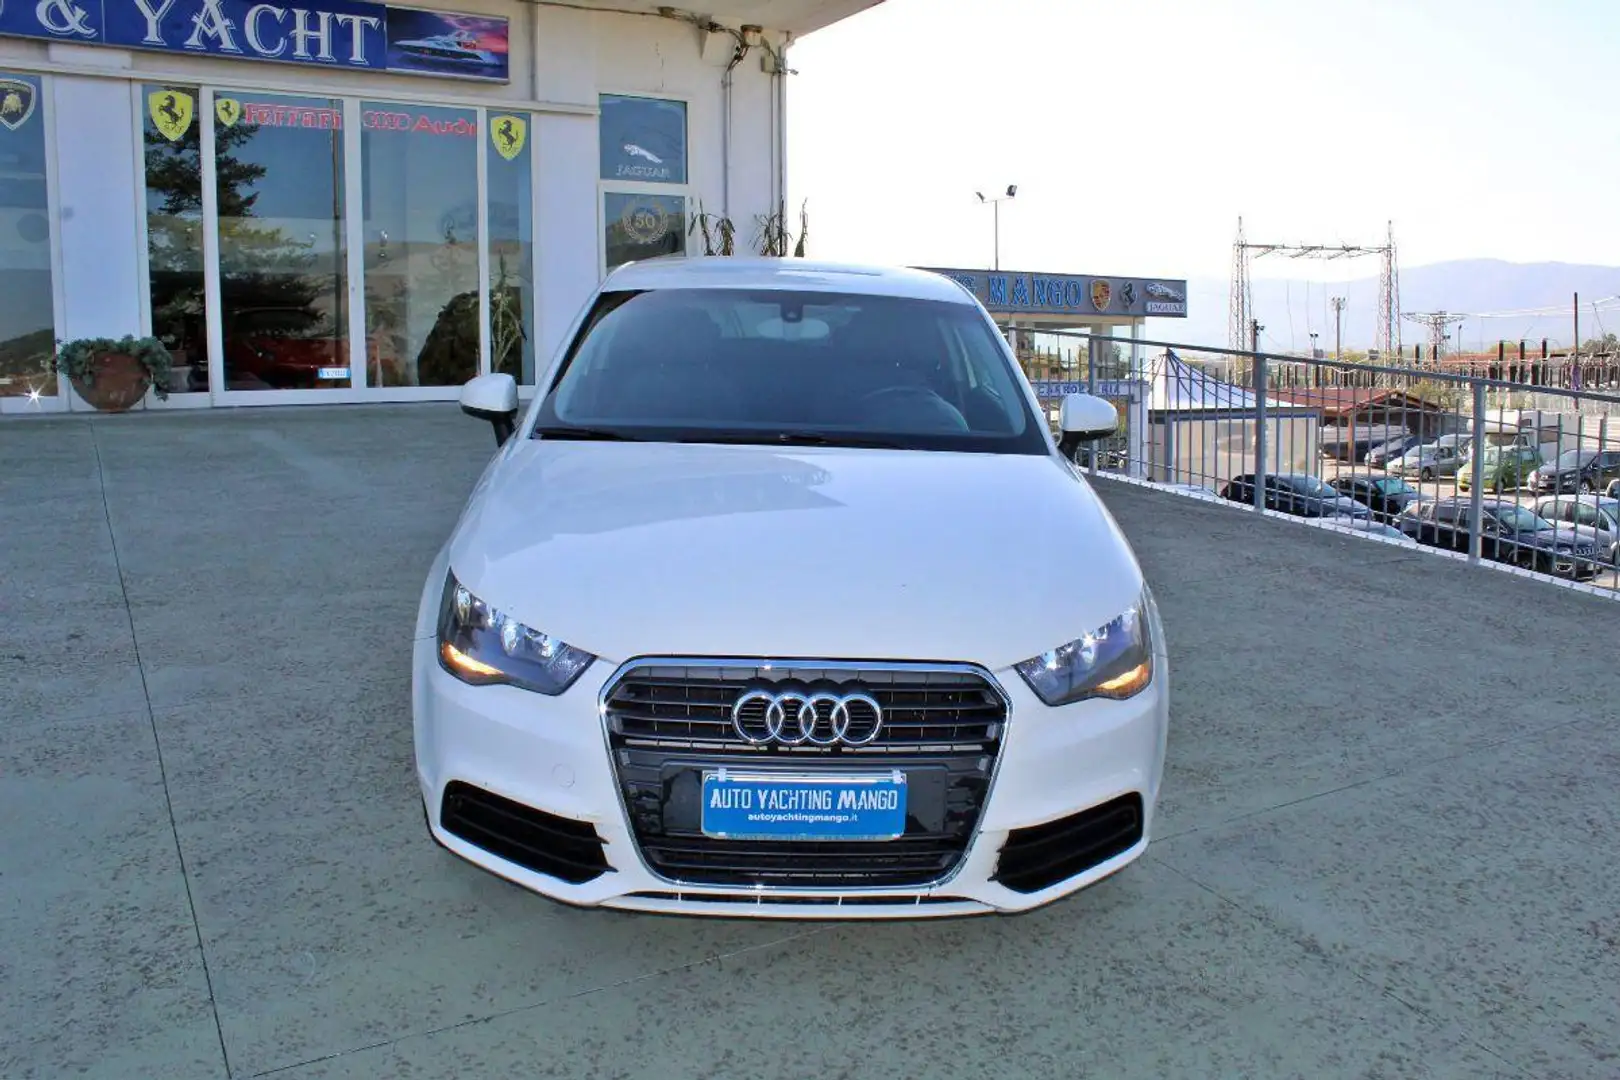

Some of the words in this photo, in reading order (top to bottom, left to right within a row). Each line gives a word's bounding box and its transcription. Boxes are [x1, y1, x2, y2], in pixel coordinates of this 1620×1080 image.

[36, 0, 98, 38] &
[132, 0, 380, 65] YACHT
[244, 103, 342, 129] Ferrari
[411, 115, 476, 136] Audi
[987, 275, 1082, 306] MANGO
[710, 788, 752, 809] AUTO
[757, 789, 832, 810] YACHTING
[837, 789, 898, 810] MANGO
[747, 812, 858, 824] autoyachtingmango.it
